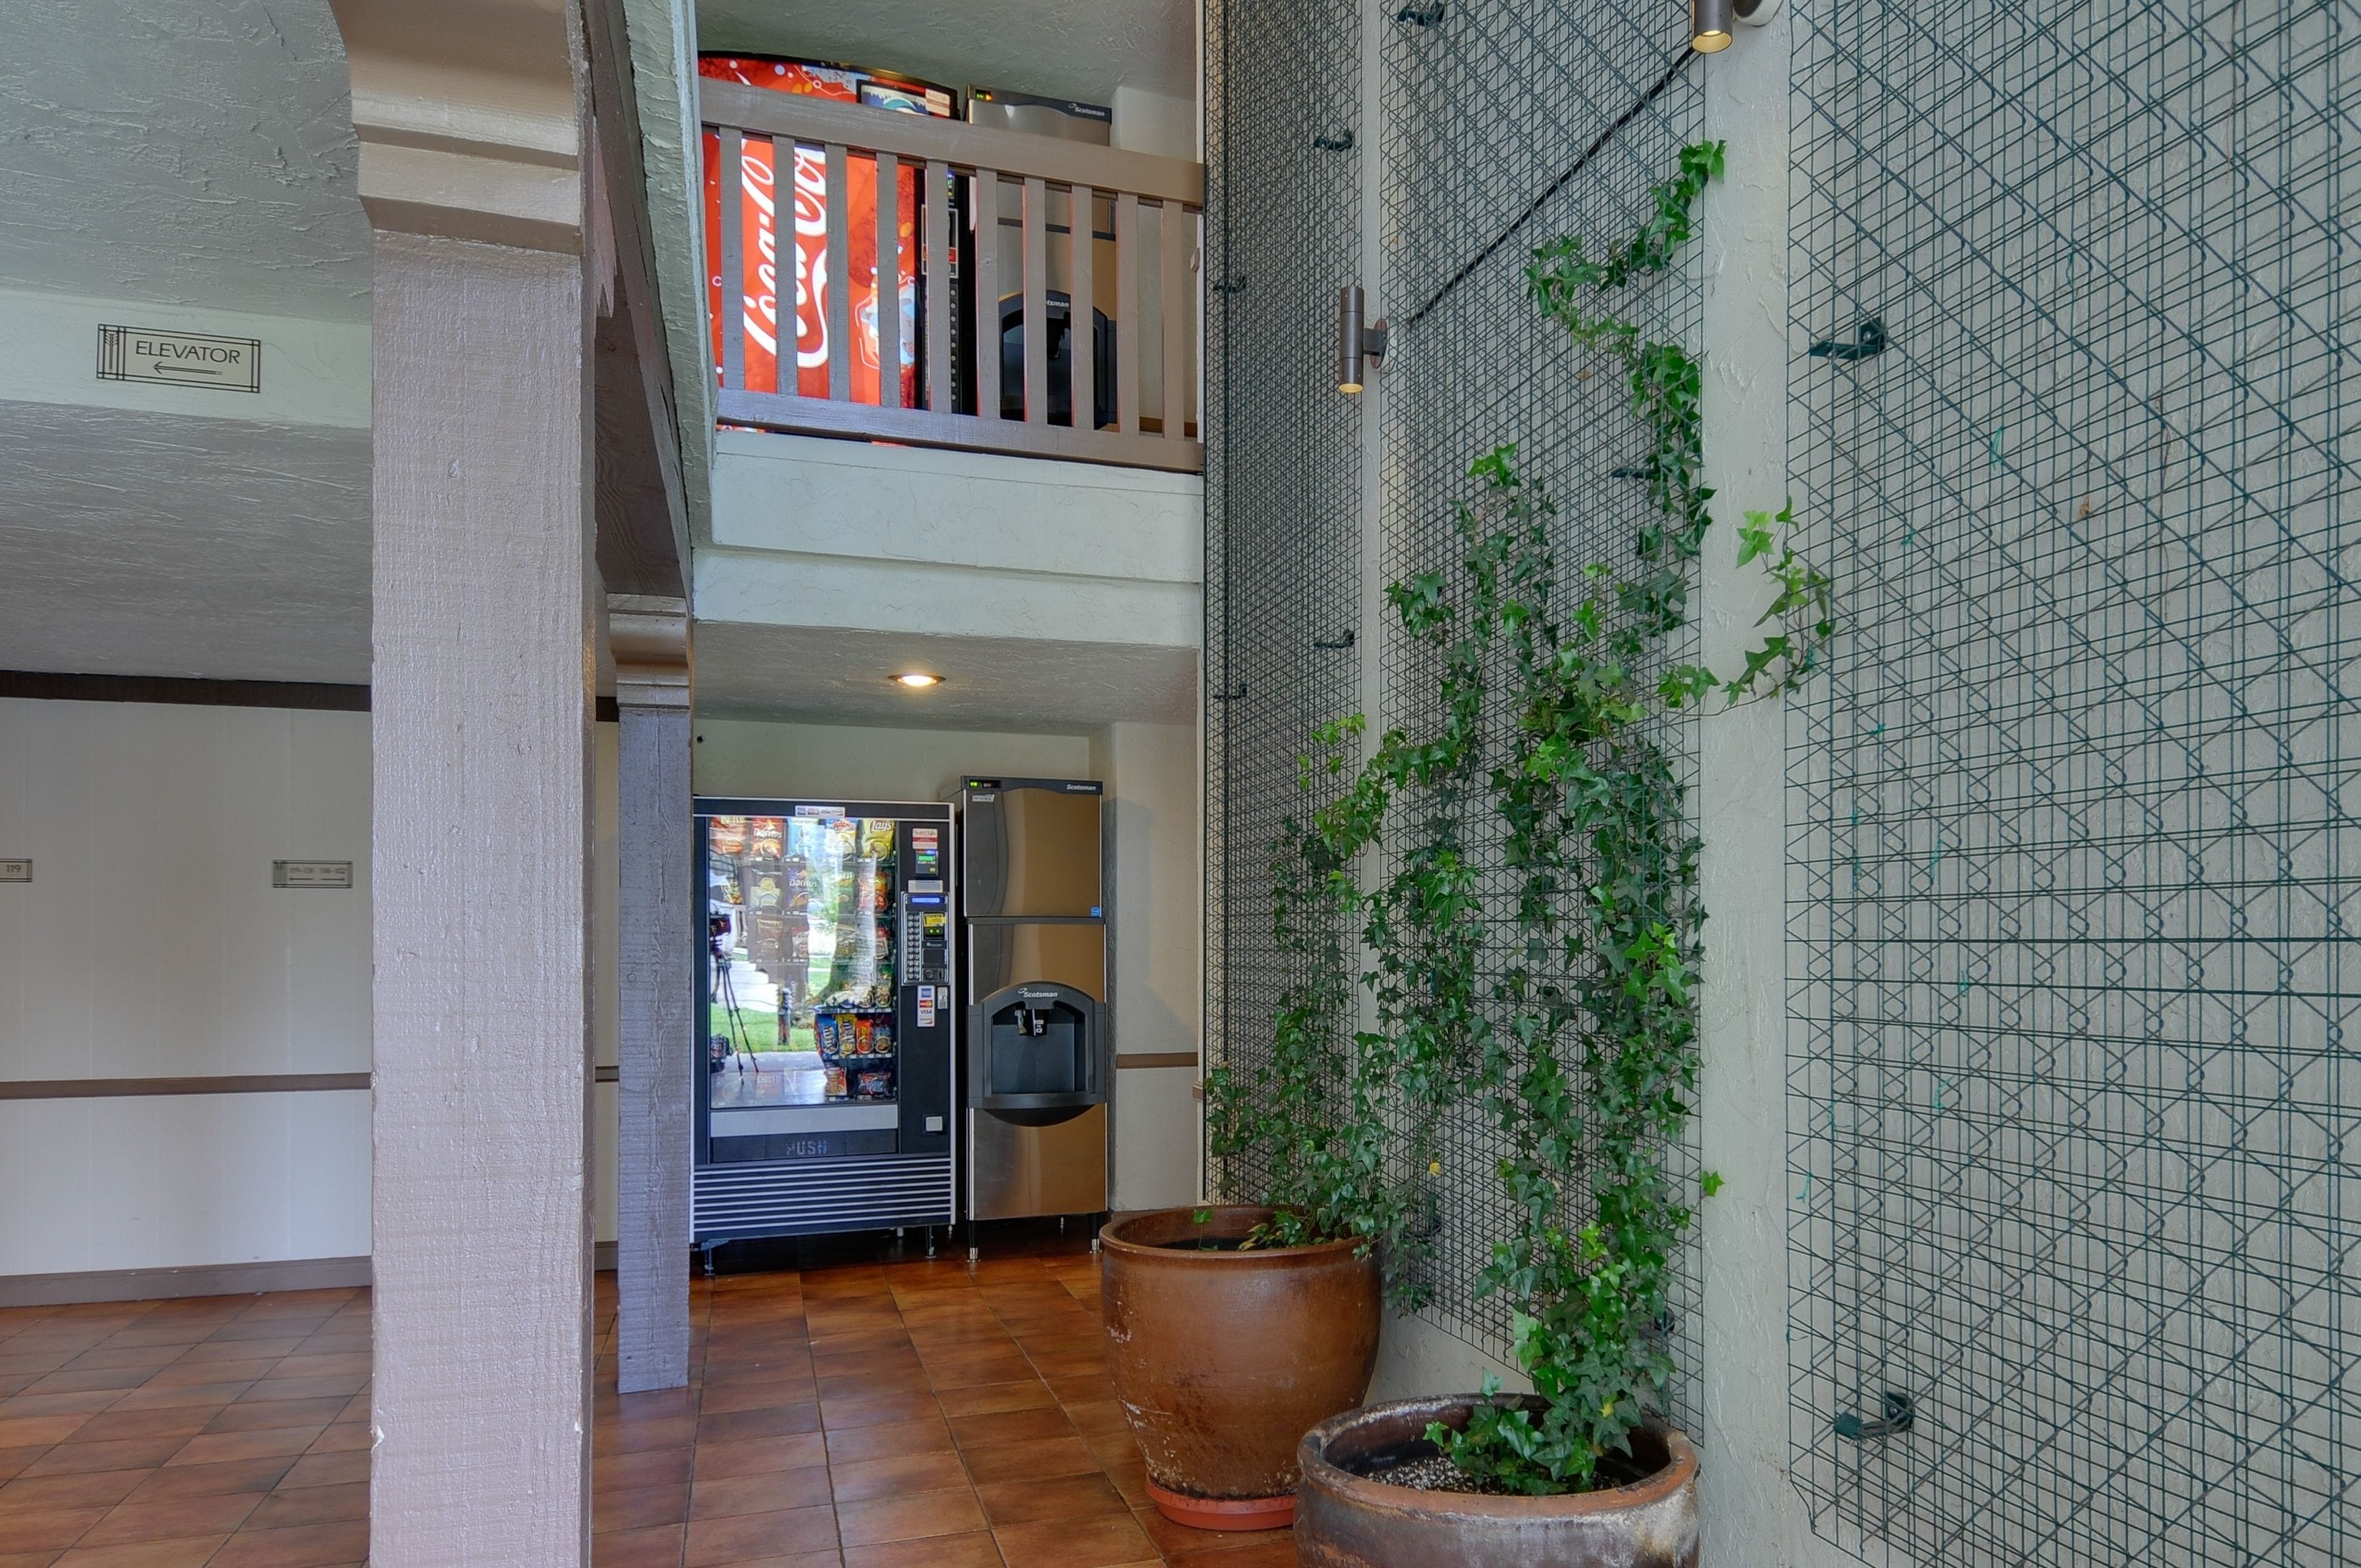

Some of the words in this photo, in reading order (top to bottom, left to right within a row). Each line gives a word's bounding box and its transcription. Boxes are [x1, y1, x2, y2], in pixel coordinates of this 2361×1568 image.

[1075, 107, 1106, 117] Scotsman
[135, 340, 241, 364] ELEVATOR
[753, 828, 782, 838] Doritos
[6, 864, 21, 873] 119
[786, 1141, 827, 1156] PUSH
